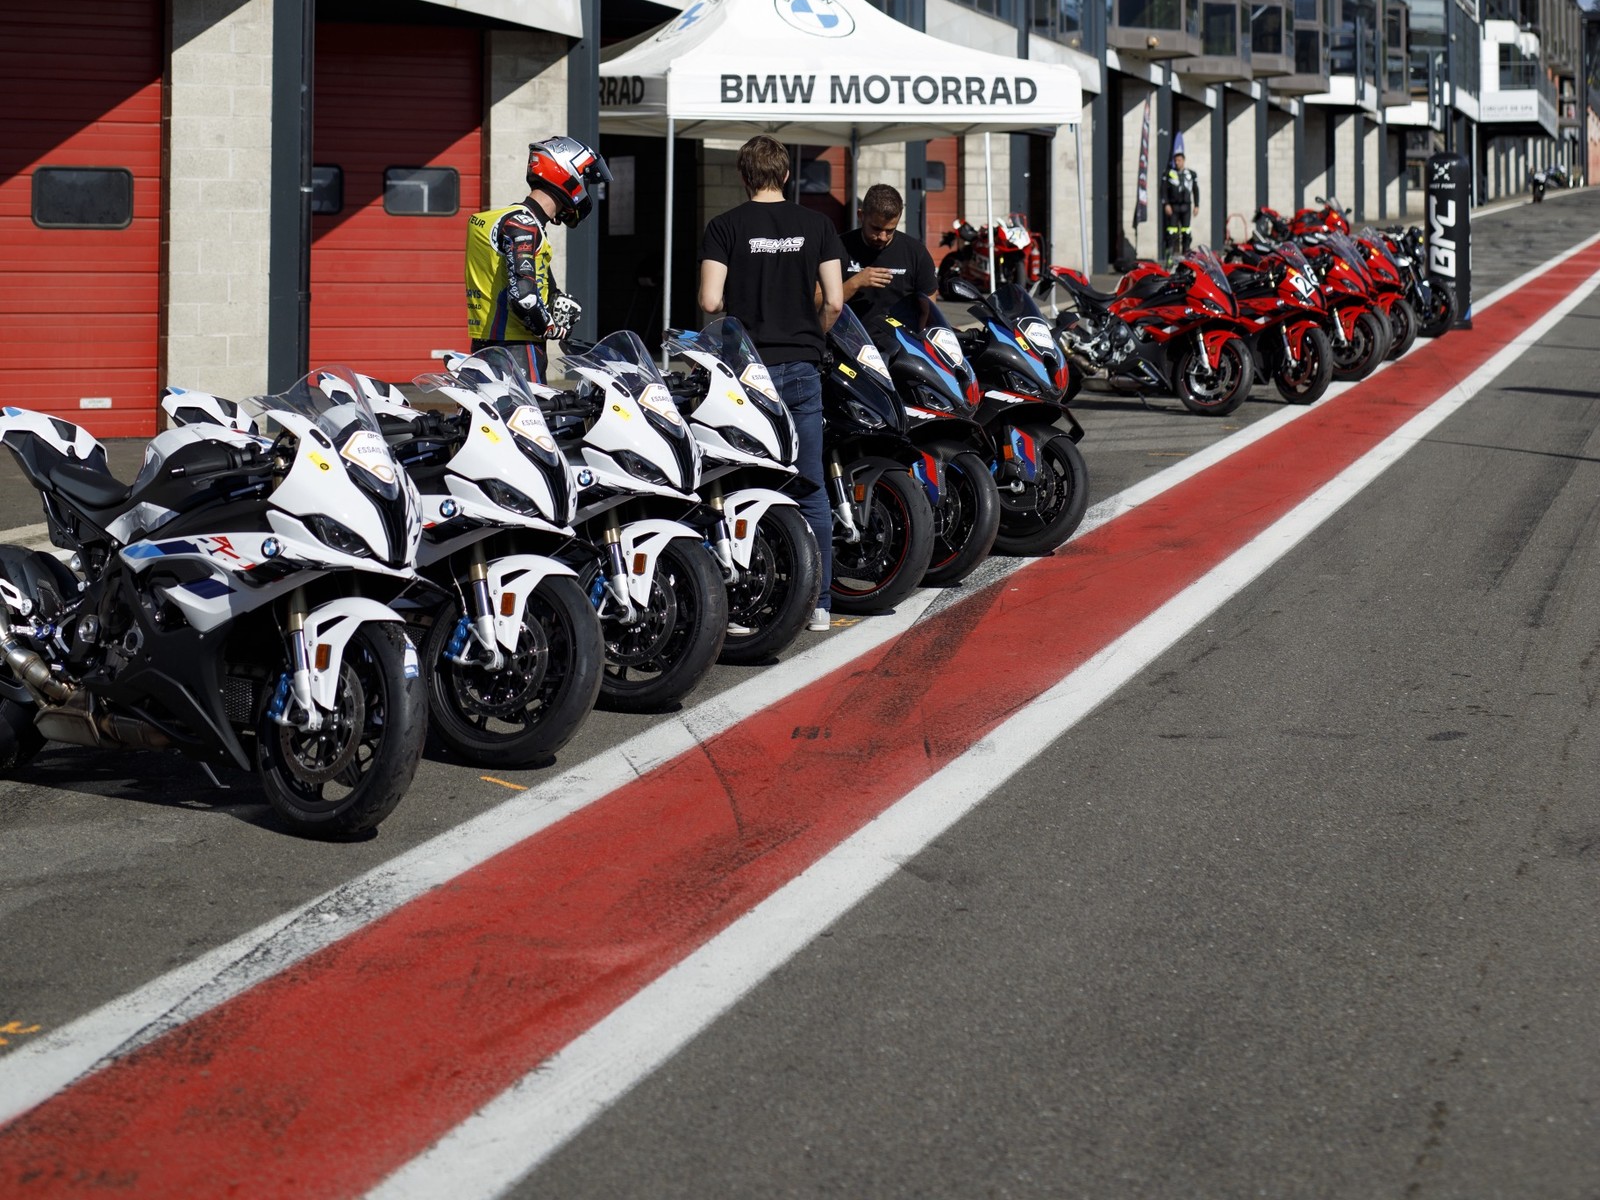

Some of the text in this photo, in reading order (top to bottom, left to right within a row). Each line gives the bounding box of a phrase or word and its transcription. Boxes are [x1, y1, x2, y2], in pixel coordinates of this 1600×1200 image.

[721, 74, 1038, 105] BMW MOTORRAD
[357, 446, 382, 455] ESSAIS
